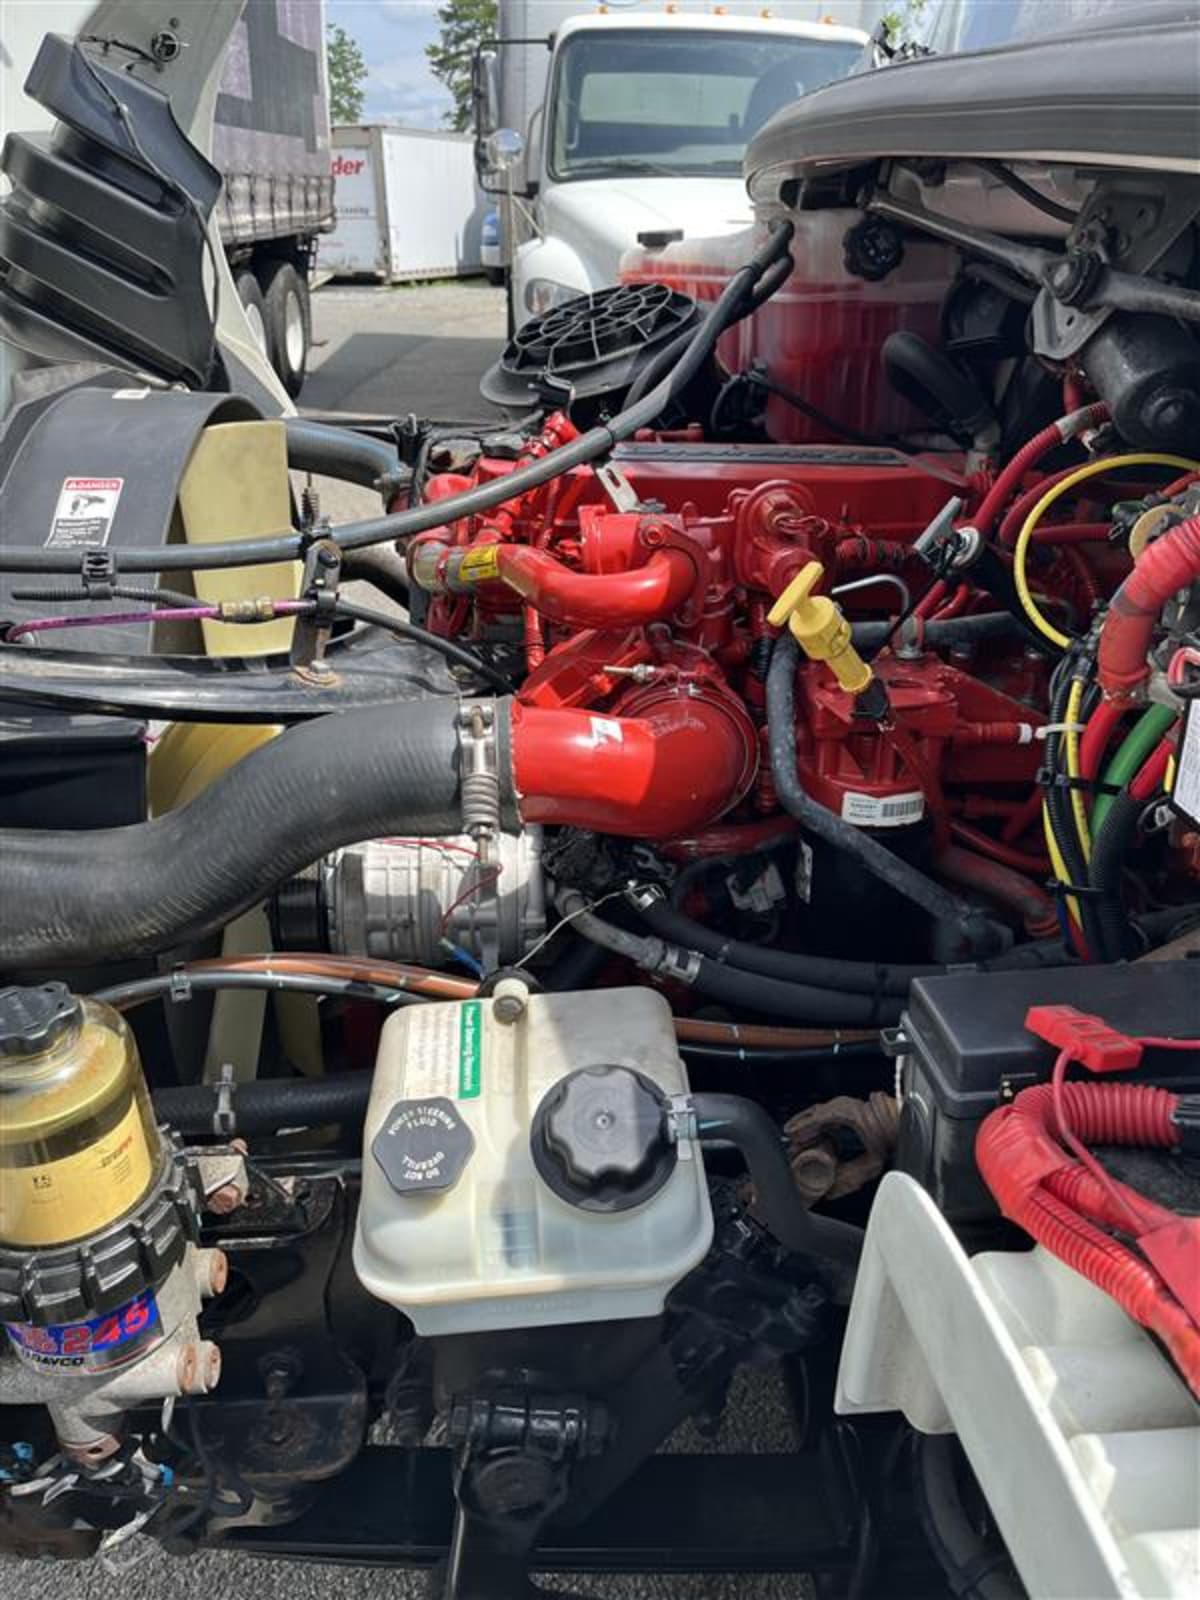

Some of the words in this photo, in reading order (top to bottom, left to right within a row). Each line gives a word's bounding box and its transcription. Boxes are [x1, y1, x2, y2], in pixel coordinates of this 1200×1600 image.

[388, 1109, 414, 1135] POWER
[417, 1106, 455, 1130] STEERING
[407, 1117, 438, 1130] FLUID
[62, 1301, 149, 1354] 245
